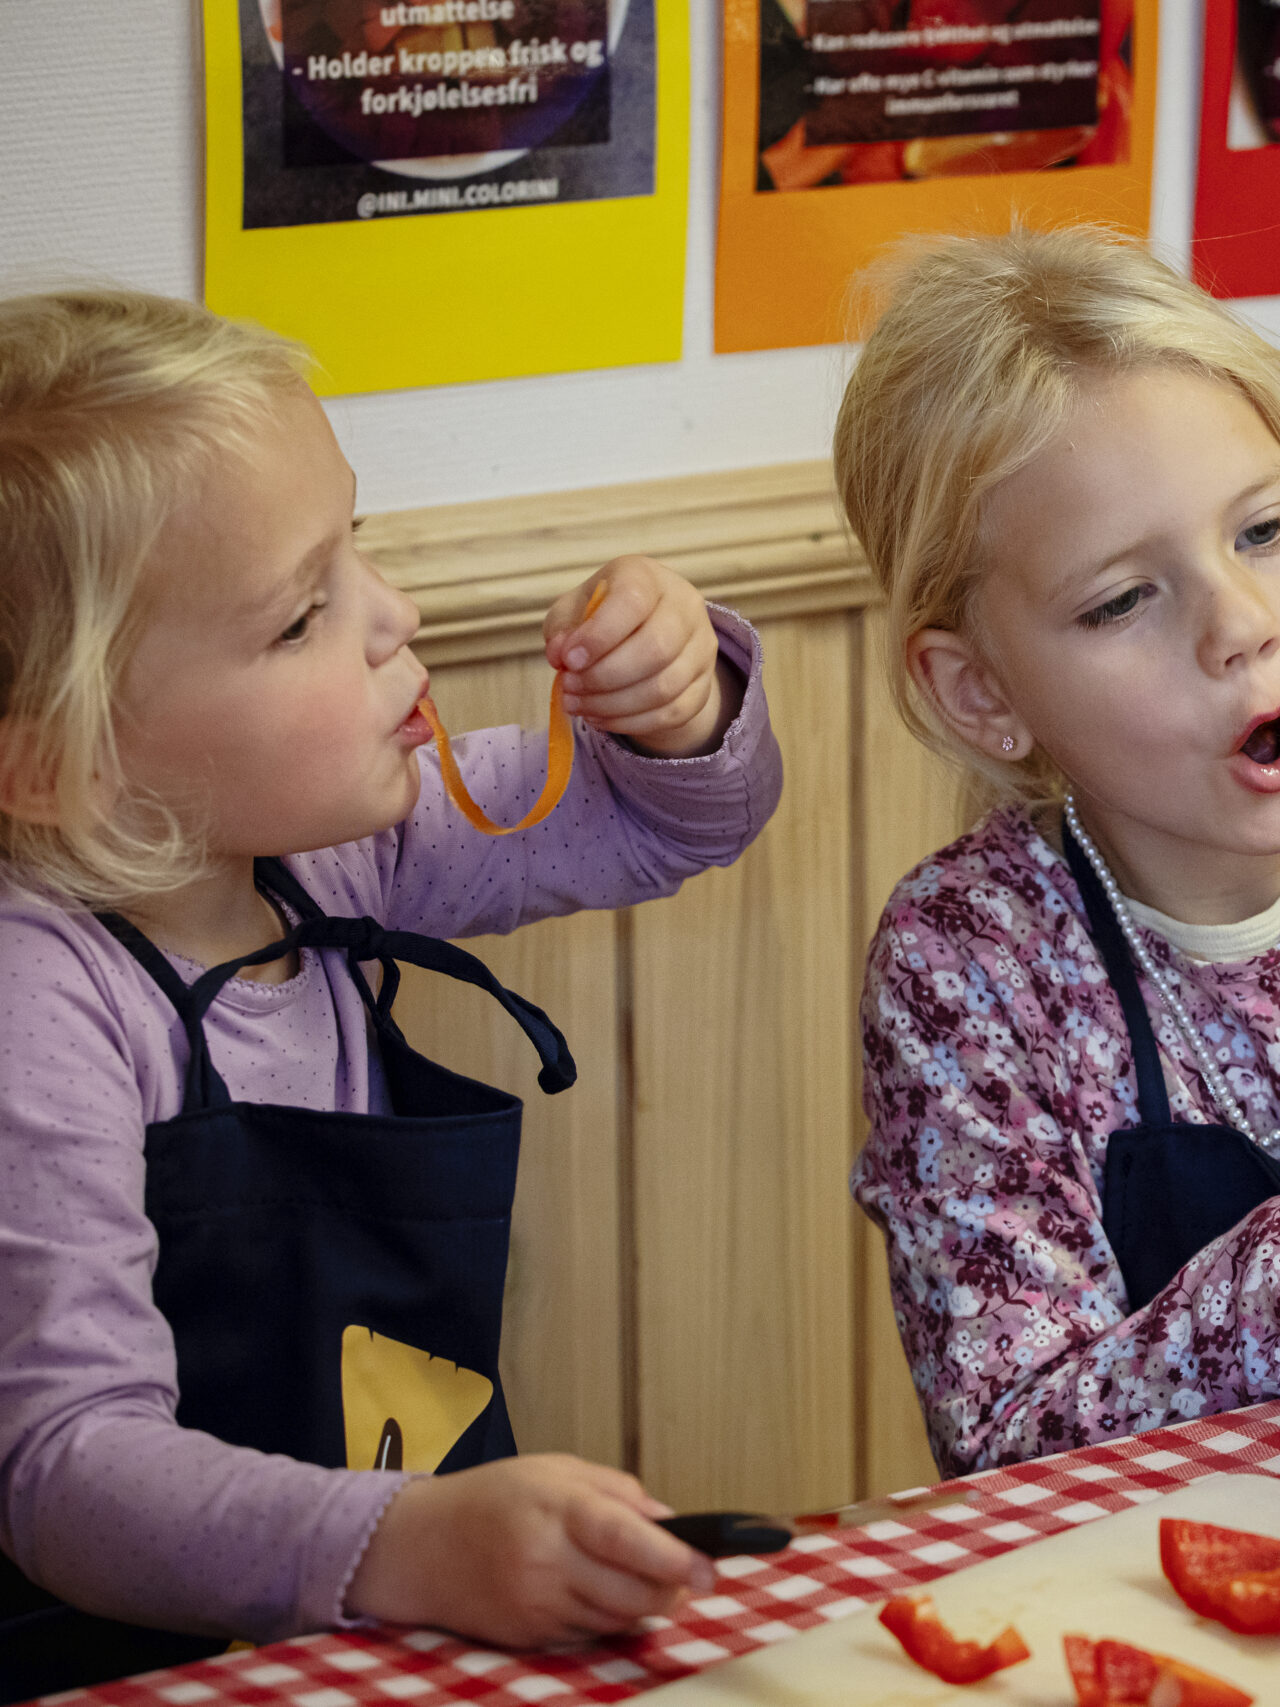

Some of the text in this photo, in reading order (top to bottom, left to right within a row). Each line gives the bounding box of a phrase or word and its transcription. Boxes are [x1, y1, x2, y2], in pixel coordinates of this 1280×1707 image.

[380, 0, 515, 27] utmattelse
[307, 51, 396, 80] Holder
[401, 47, 507, 76] kroppen
[508, 37, 567, 67] frisk
[569, 39, 605, 68] og
[361, 74, 539, 117] forkjølelsesfri
